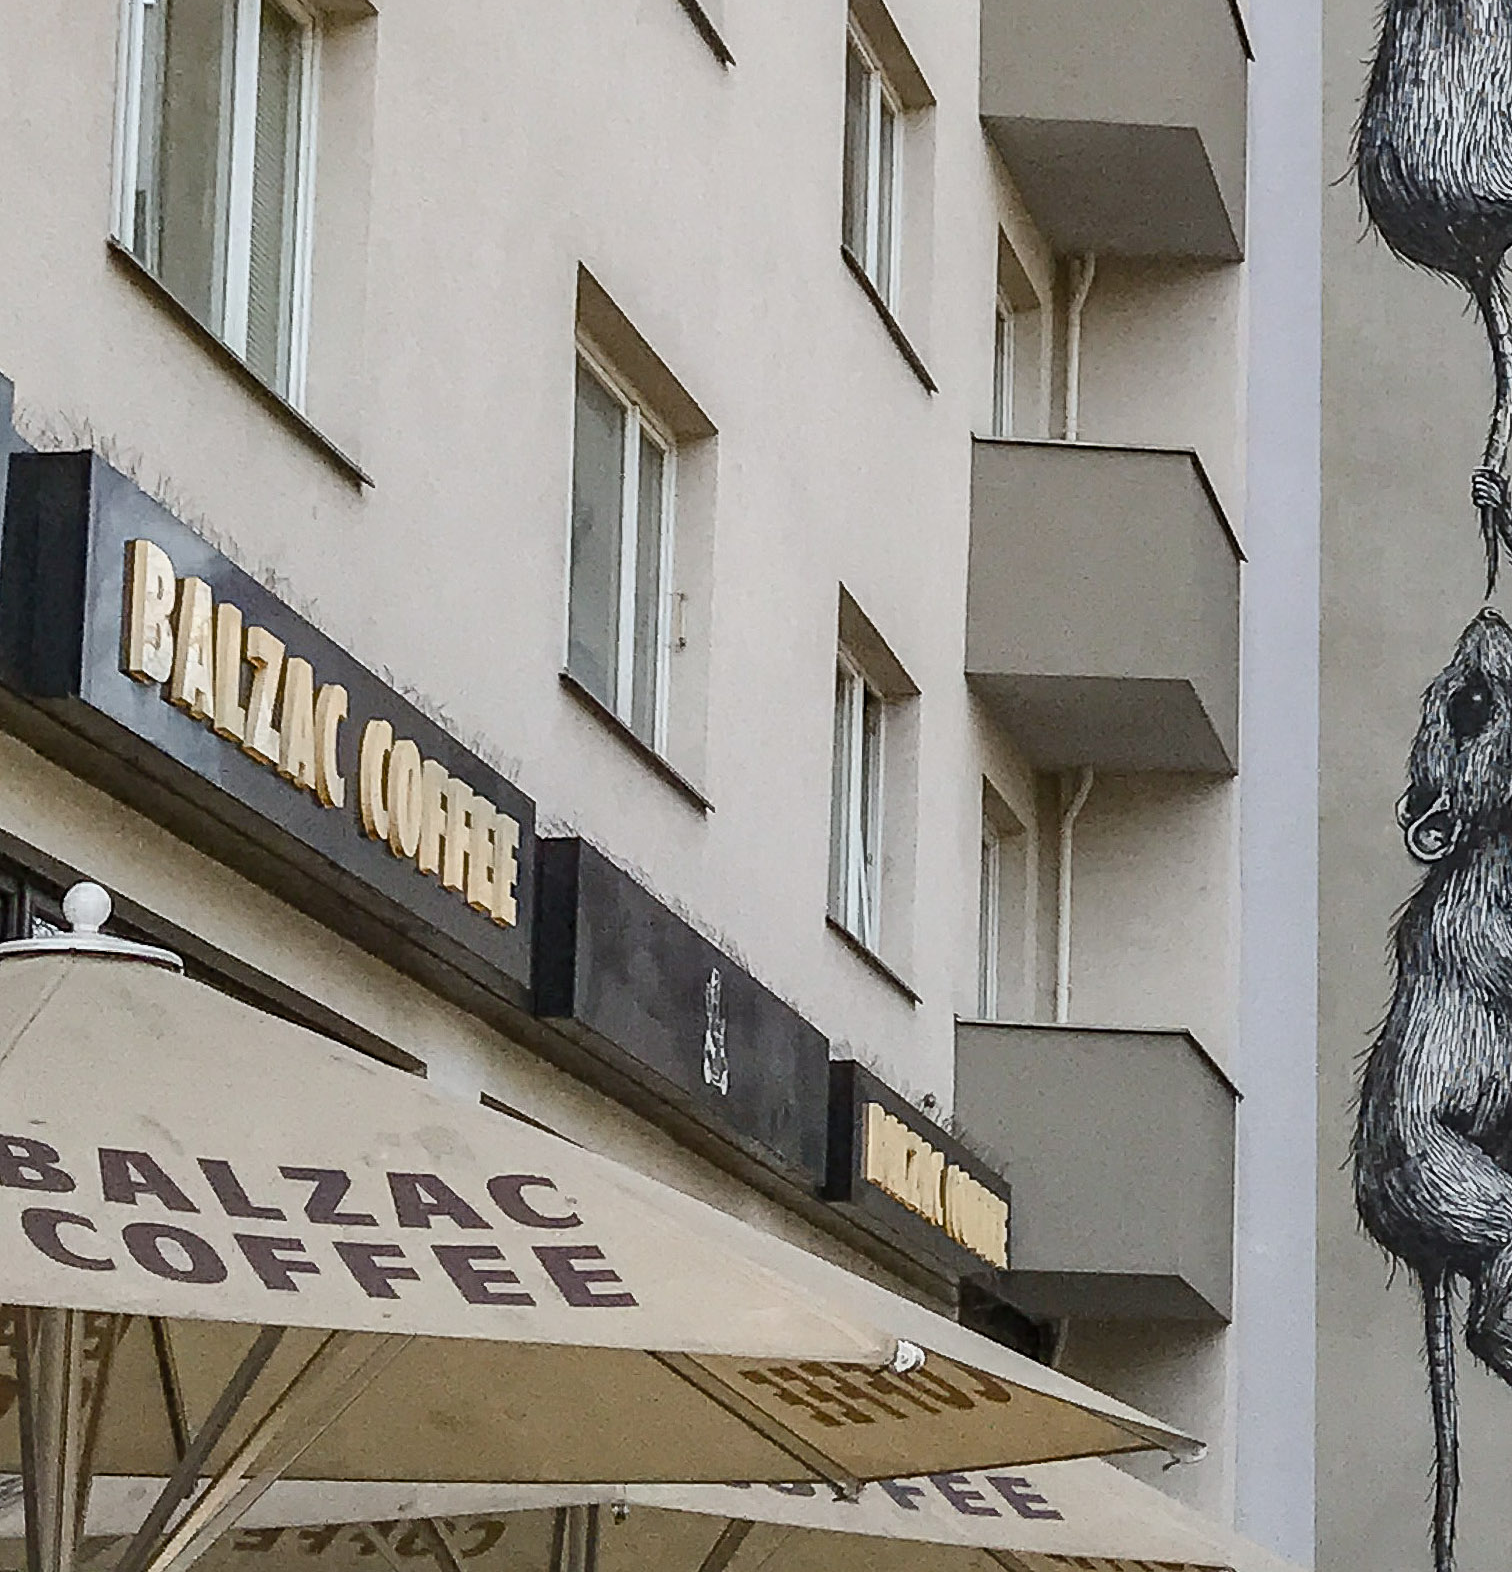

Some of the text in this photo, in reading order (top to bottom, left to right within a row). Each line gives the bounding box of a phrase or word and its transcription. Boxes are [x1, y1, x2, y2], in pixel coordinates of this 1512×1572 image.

[122, 538, 520, 927] BALZAC COFFEE
[0, 1134, 584, 1230] BALZAC
[21, 1207, 639, 1307] COFFEE
